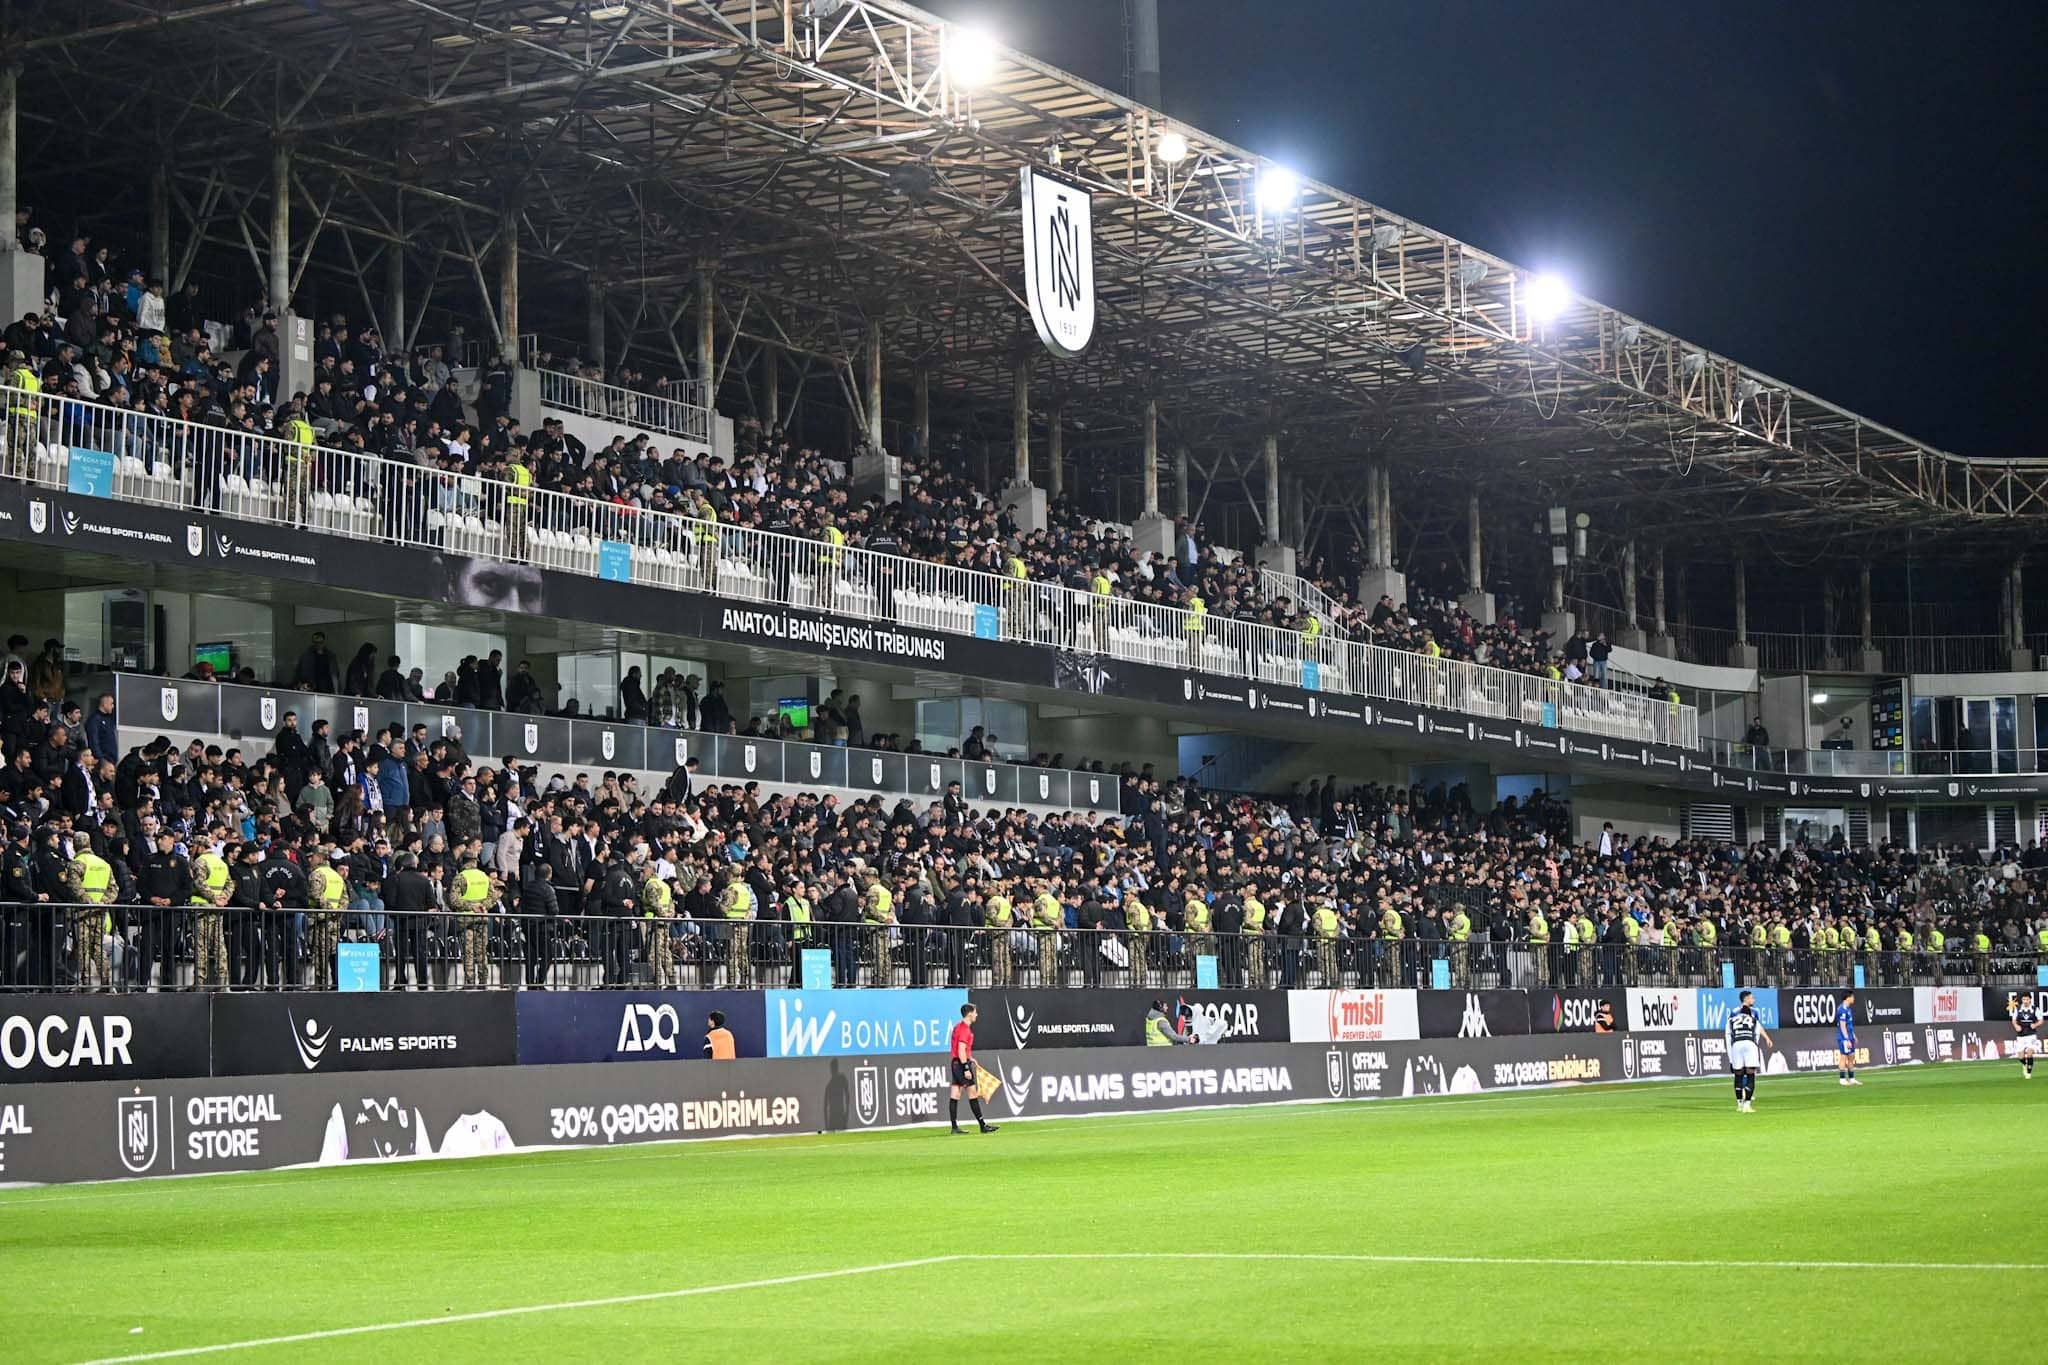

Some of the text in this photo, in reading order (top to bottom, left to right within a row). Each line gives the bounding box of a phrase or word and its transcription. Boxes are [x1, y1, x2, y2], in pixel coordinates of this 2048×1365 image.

[82, 523, 172, 543] PALMS SPORTS ARENA
[235, 546, 316, 565] PALMS SPORTS ARENA
[722, 608, 945, 660] ANATOLİ BANİŞEVSKİ TRİBUNASI
[1342, 993, 1383, 1026] misli
[1564, 998, 1602, 1027] SOCA
[1641, 996, 1674, 1027] baku
[1732, 1015, 1754, 1030] 24
[1794, 994, 1836, 1025] GESCO
[617, 1004, 680, 1053] ADQ
[841, 1020, 905, 1049] BONA
[1038, 1023, 1115, 1034] PALMS SPORTS ARENA
[340, 1035, 457, 1052] PALMS SPORTS
[1352, 1051, 1389, 1070] OFFICIAL
[894, 1066, 951, 1090] OFFICIAL
[1041, 1066, 1292, 1103] PALMS SPORTS ARENA
[1353, 1072, 1382, 1092] STORE
[187, 1093, 282, 1126] OFFICIAL
[550, 1091, 800, 1144] 30% QƏDƏR ENDİRİMLƏR
[896, 1093, 938, 1117] STORE
[188, 1128, 260, 1160] STORE
